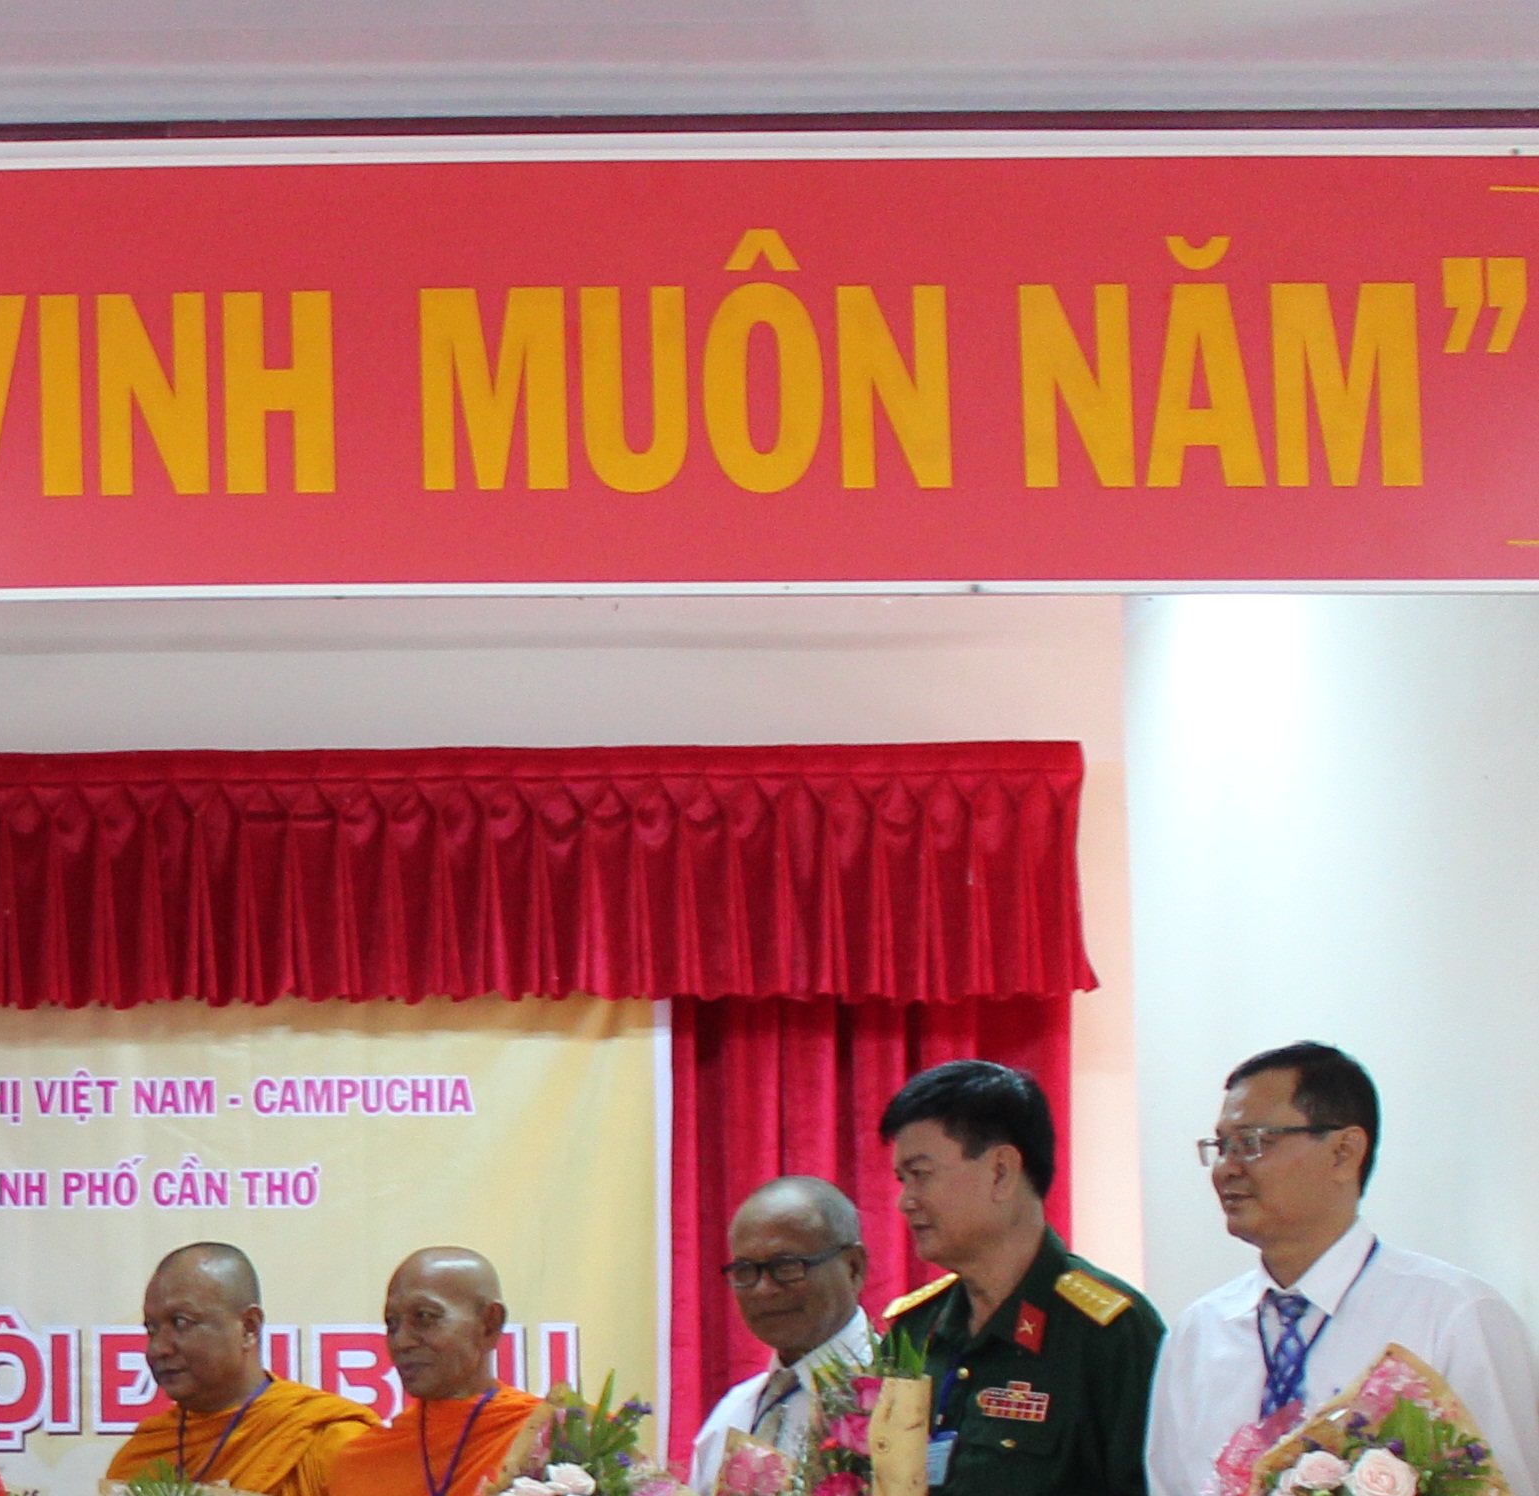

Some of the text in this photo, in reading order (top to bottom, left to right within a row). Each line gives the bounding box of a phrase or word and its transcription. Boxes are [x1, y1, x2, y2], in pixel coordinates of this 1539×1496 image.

[422, 228, 946, 493] MUÔN
[34, 1070, 120, 1122] VIỆT
[133, 1079, 216, 1115] NAM
[253, 1078, 474, 1114] CAMPUCHIA
[63, 1155, 141, 1207] PHỐ
[152, 1155, 229, 1207] CẦN
[240, 1165, 320, 1207] THƠ
